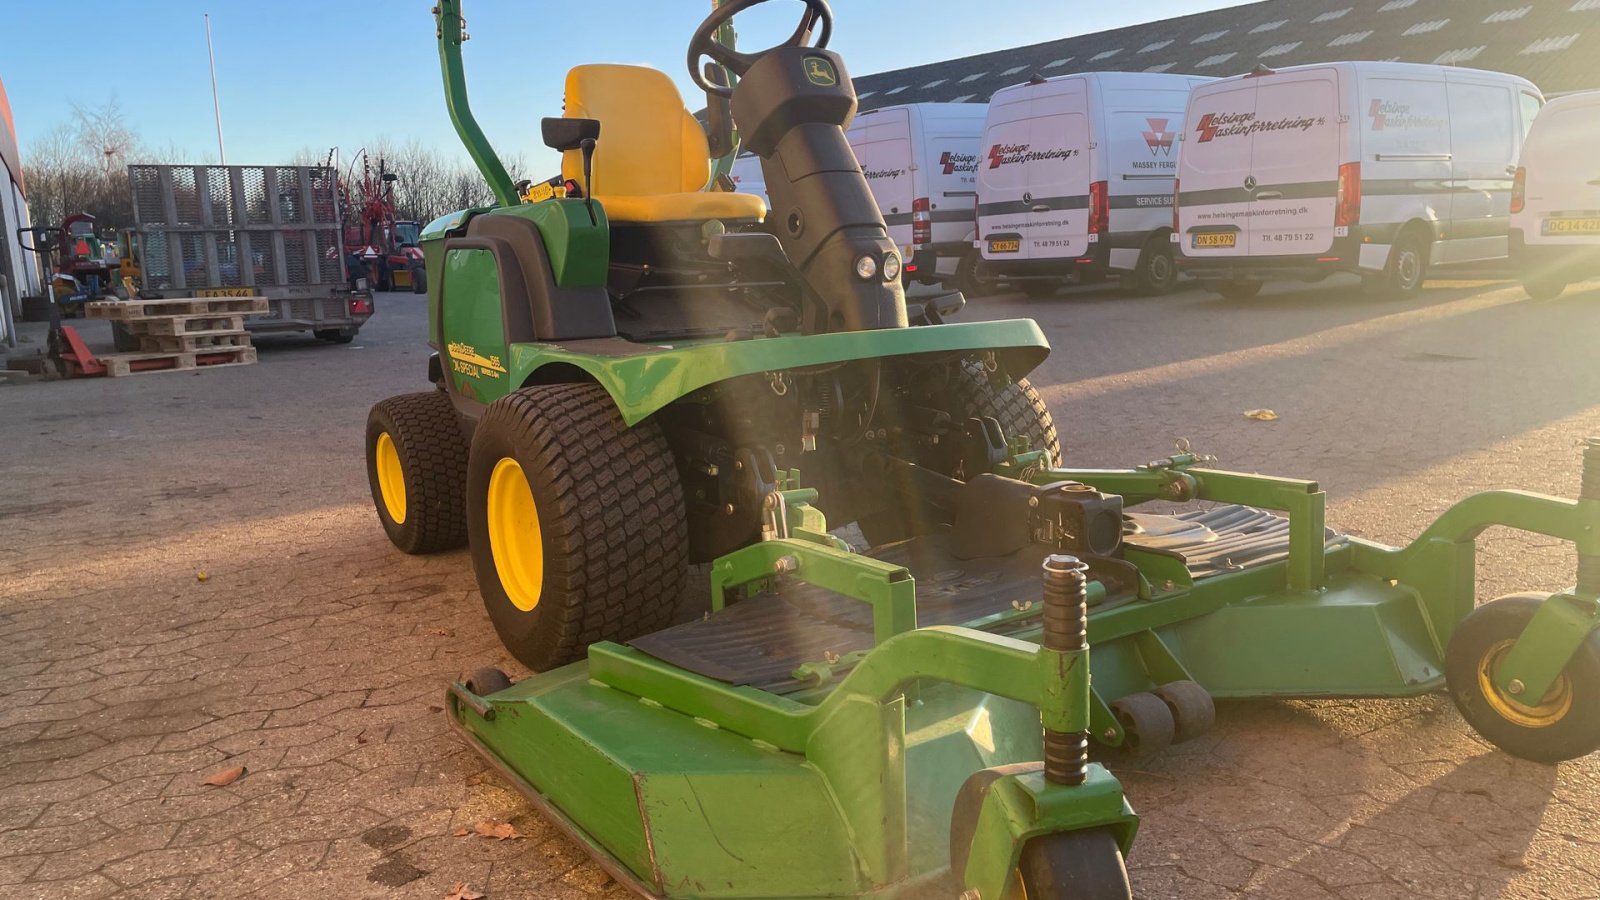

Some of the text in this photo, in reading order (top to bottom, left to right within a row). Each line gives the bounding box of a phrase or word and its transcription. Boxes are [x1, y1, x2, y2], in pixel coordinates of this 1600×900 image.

[1196, 112, 1256, 132] elsinge
[1198, 116, 1315, 143] askinforretning
[988, 143, 1030, 160] elsinge
[1132, 161, 1158, 169] MASSEY
[1136, 197, 1163, 206] SERVICE
[1197, 234, 1234, 245] DN 58 979
[1304, 233, 1314, 241] 22
